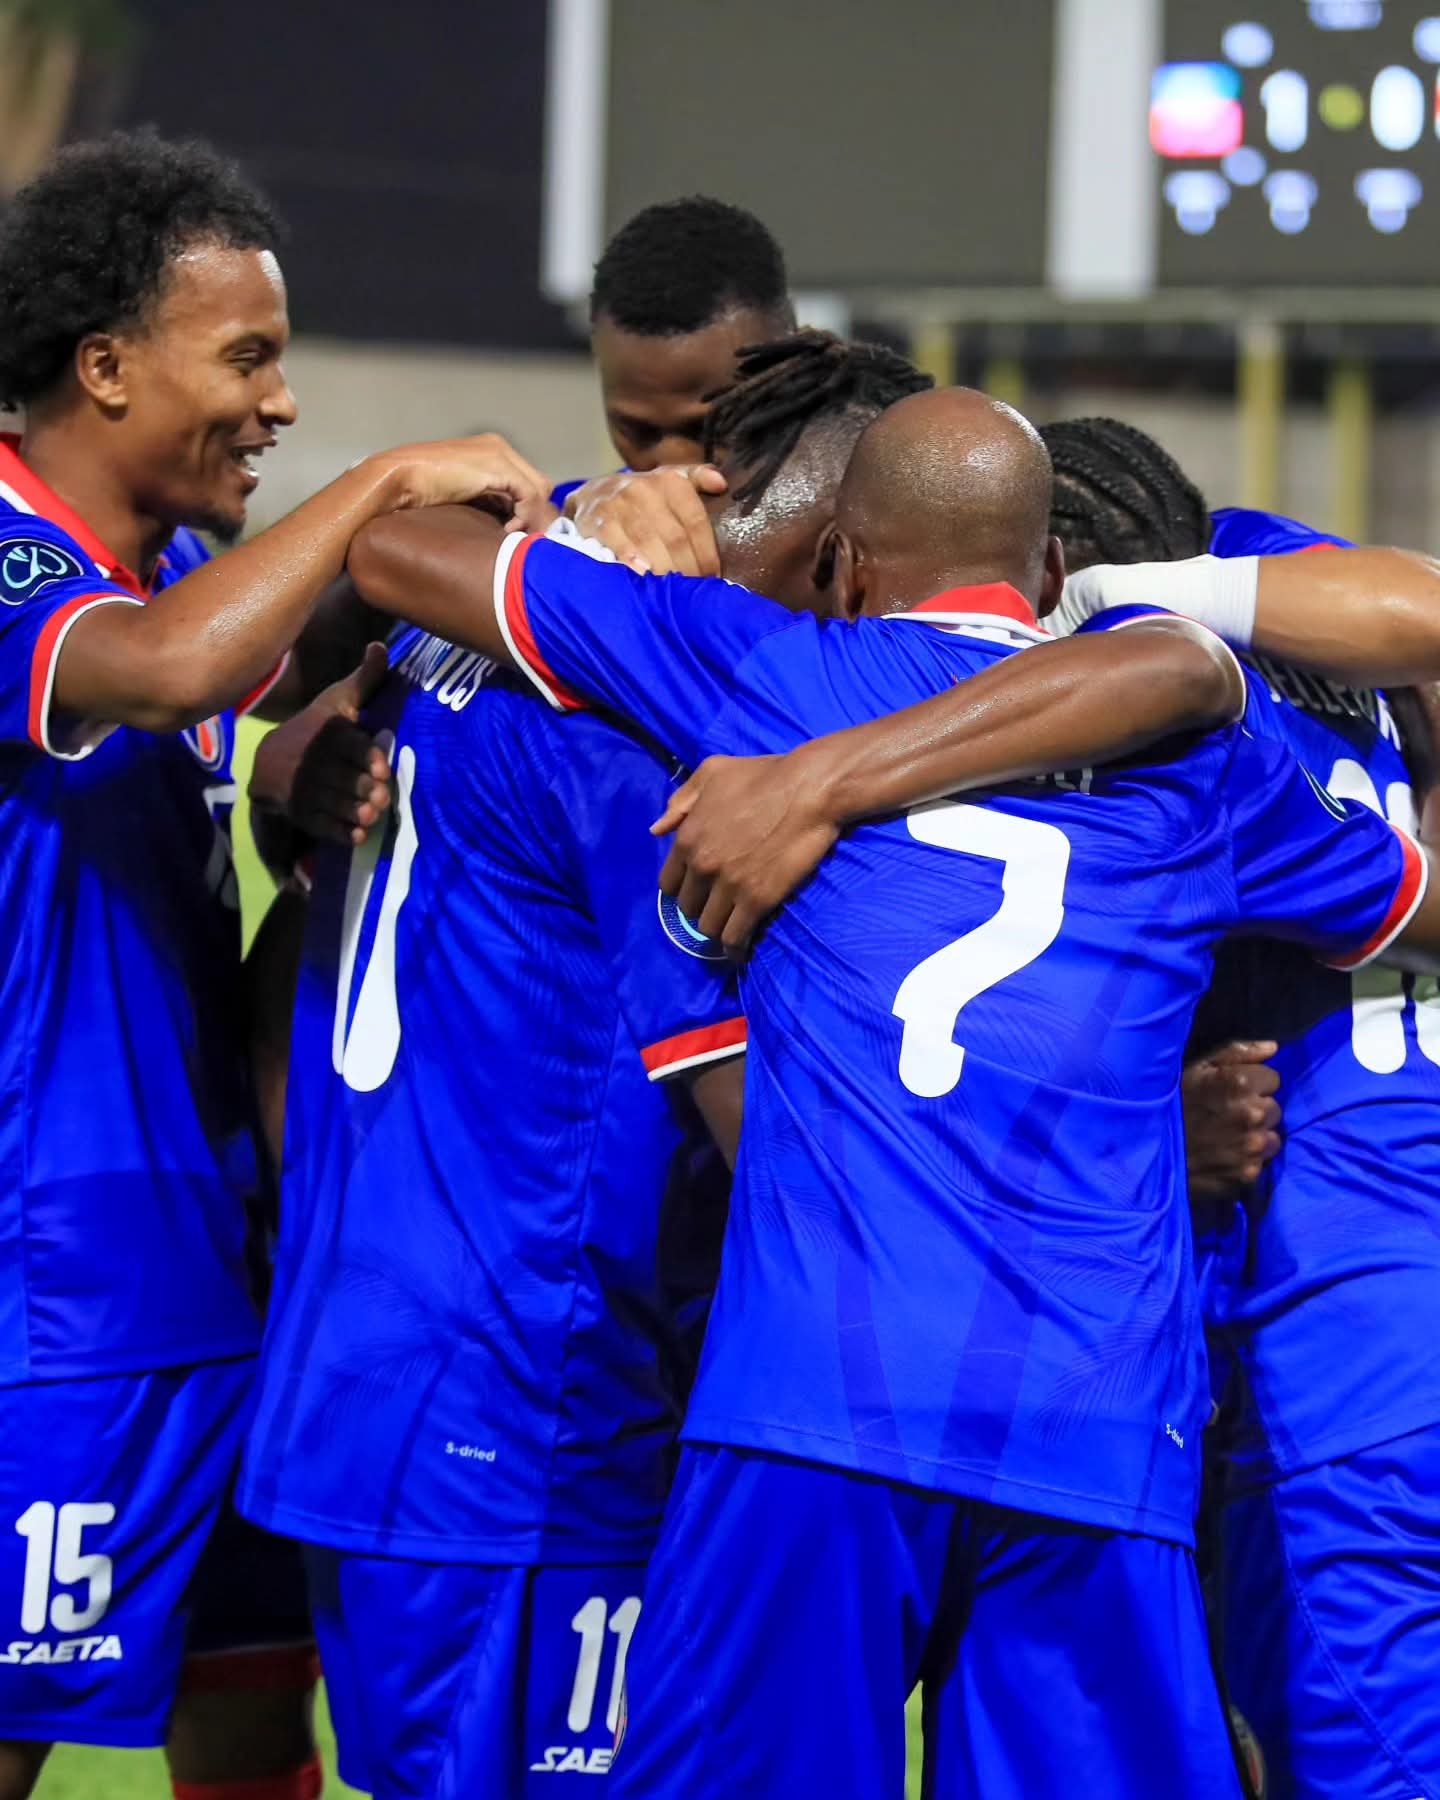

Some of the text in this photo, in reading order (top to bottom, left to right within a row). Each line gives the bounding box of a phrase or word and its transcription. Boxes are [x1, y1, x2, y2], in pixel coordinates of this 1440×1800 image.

[892, 799, 1071, 1098] 7
[445, 1441, 497, 1462] S-dried
[15, 1501, 116, 1634] 15
[0, 1635, 123, 1665] SAETA
[567, 1596, 642, 1733] 11
[529, 1746, 615, 1774] SAE
